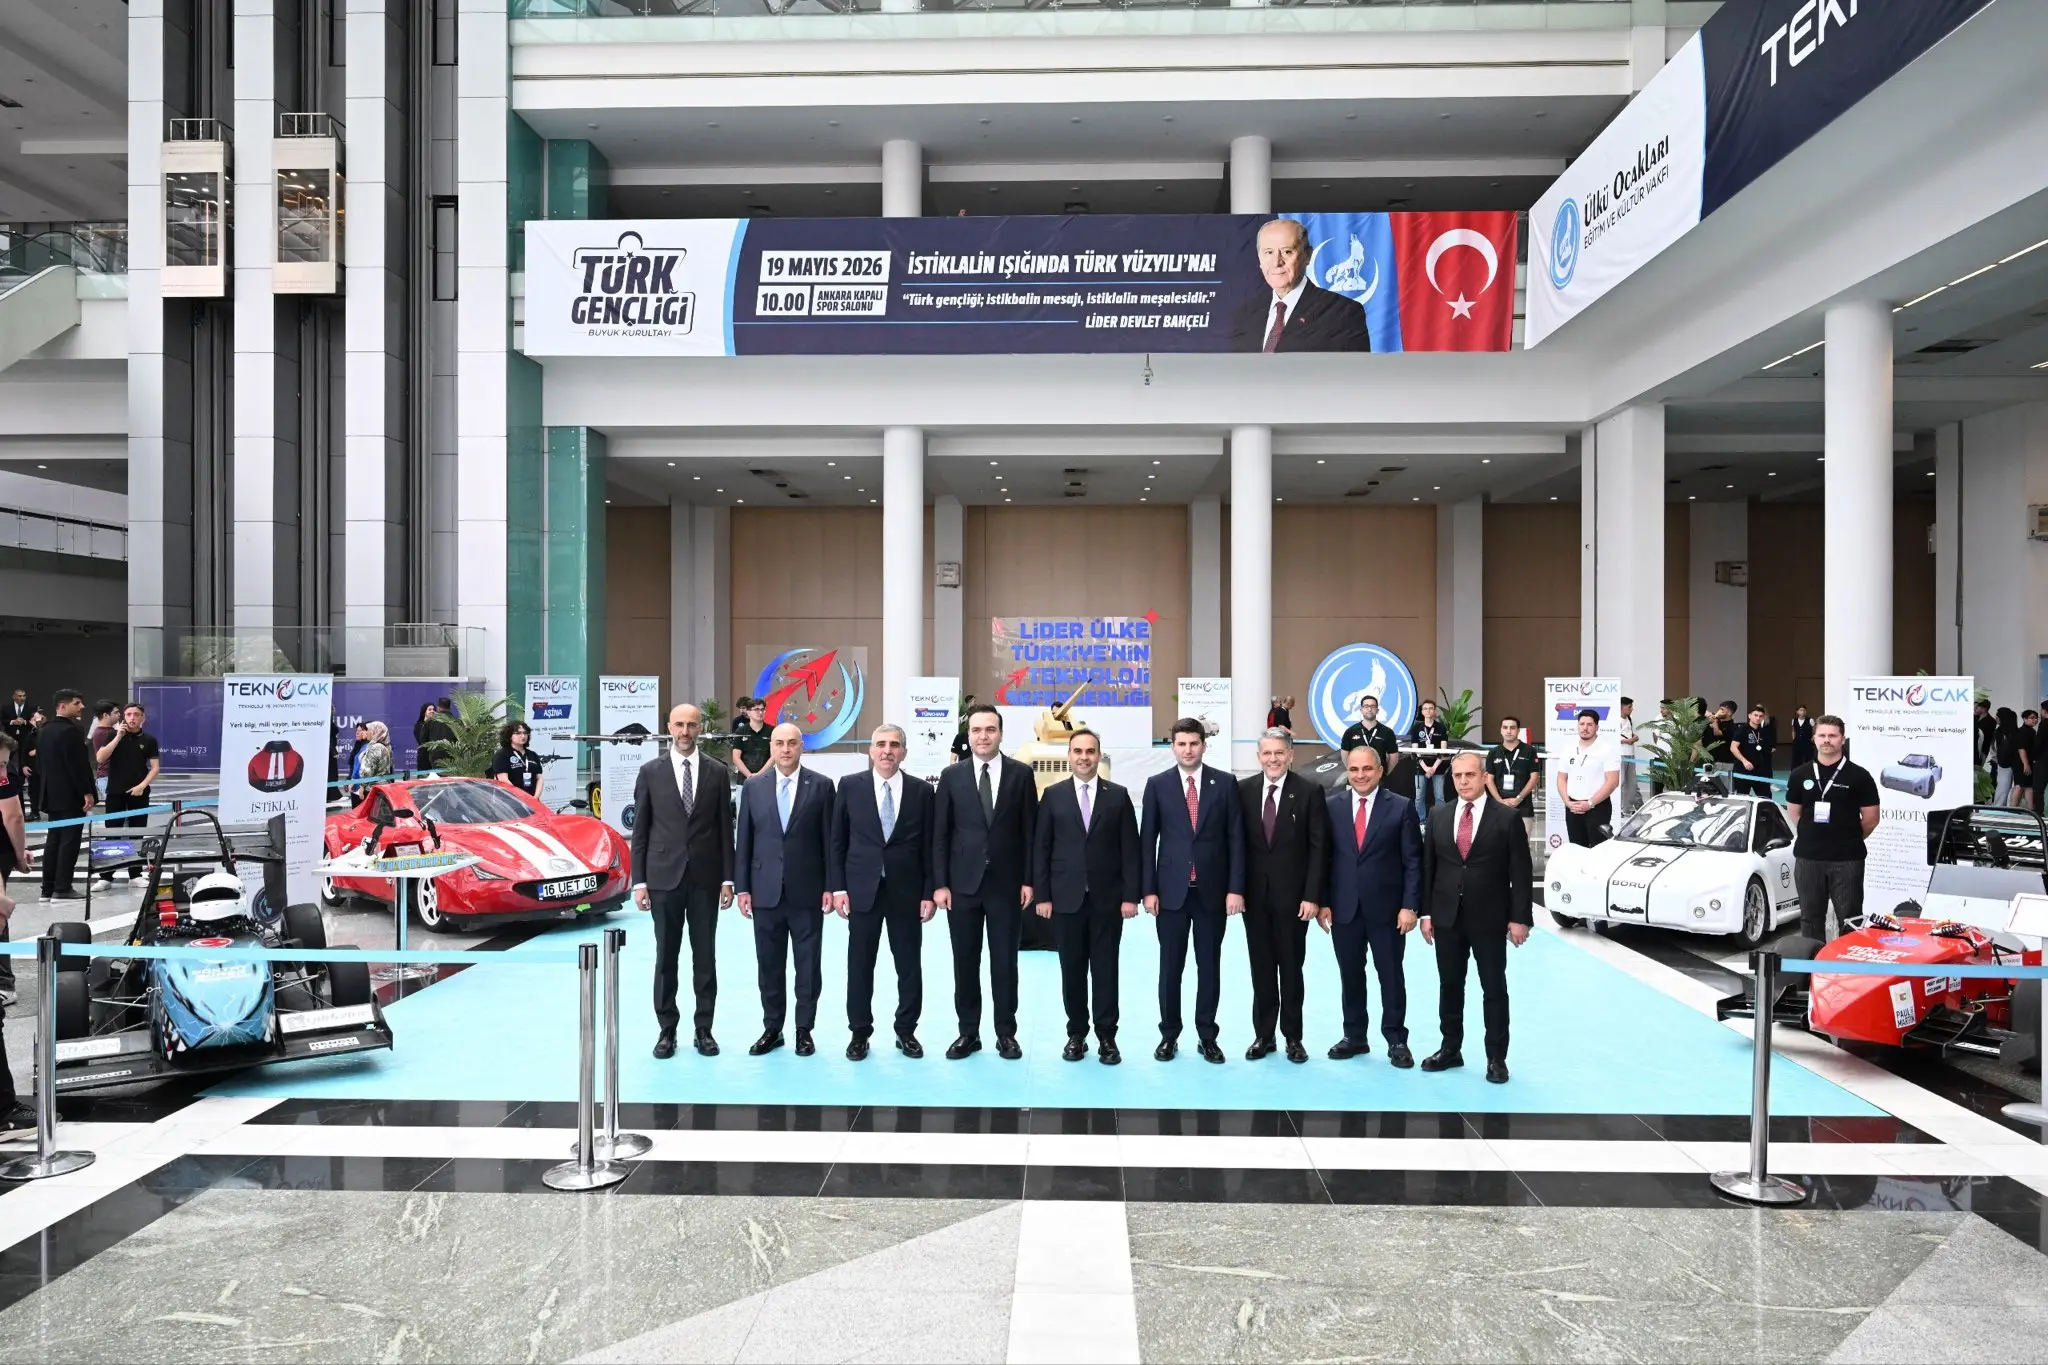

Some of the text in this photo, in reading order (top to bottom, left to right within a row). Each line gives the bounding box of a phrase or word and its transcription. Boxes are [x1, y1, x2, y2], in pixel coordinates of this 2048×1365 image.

[1761, 0, 1858, 88] TEK
[1606, 211, 1616, 229] VE
[1616, 187, 1645, 219] KÜLTÜR
[1646, 164, 1669, 195] VAKFI
[767, 257, 883, 276] 19 MAYIS 2026
[907, 250, 996, 274] İSTİKLALİN
[998, 250, 1069, 279] IŞIĞINDA
[1074, 250, 1118, 273] TÜRK
[581, 255, 679, 294] TÜRK
[761, 292, 805, 312] 10.00
[817, 290, 883, 301] ANKARA KAPALI
[936, 293, 985, 309] gençliği;
[986, 292, 1040, 306] istikbalin
[1087, 292, 1138, 305] istiklalin
[816, 301, 874, 311] SPOR SALONU
[1085, 312, 1210, 331] LİDER DEVLET BAHÇELİ
[1020, 618, 1149, 639] LİDER ÜLKE
[1031, 667, 1149, 685] TEKNOLOJİ
[544, 884, 555, 896] 16
[558, 880, 580, 893] UET
[585, 877, 596, 889] 06
[1896, 1008, 1910, 1019] PAUL
